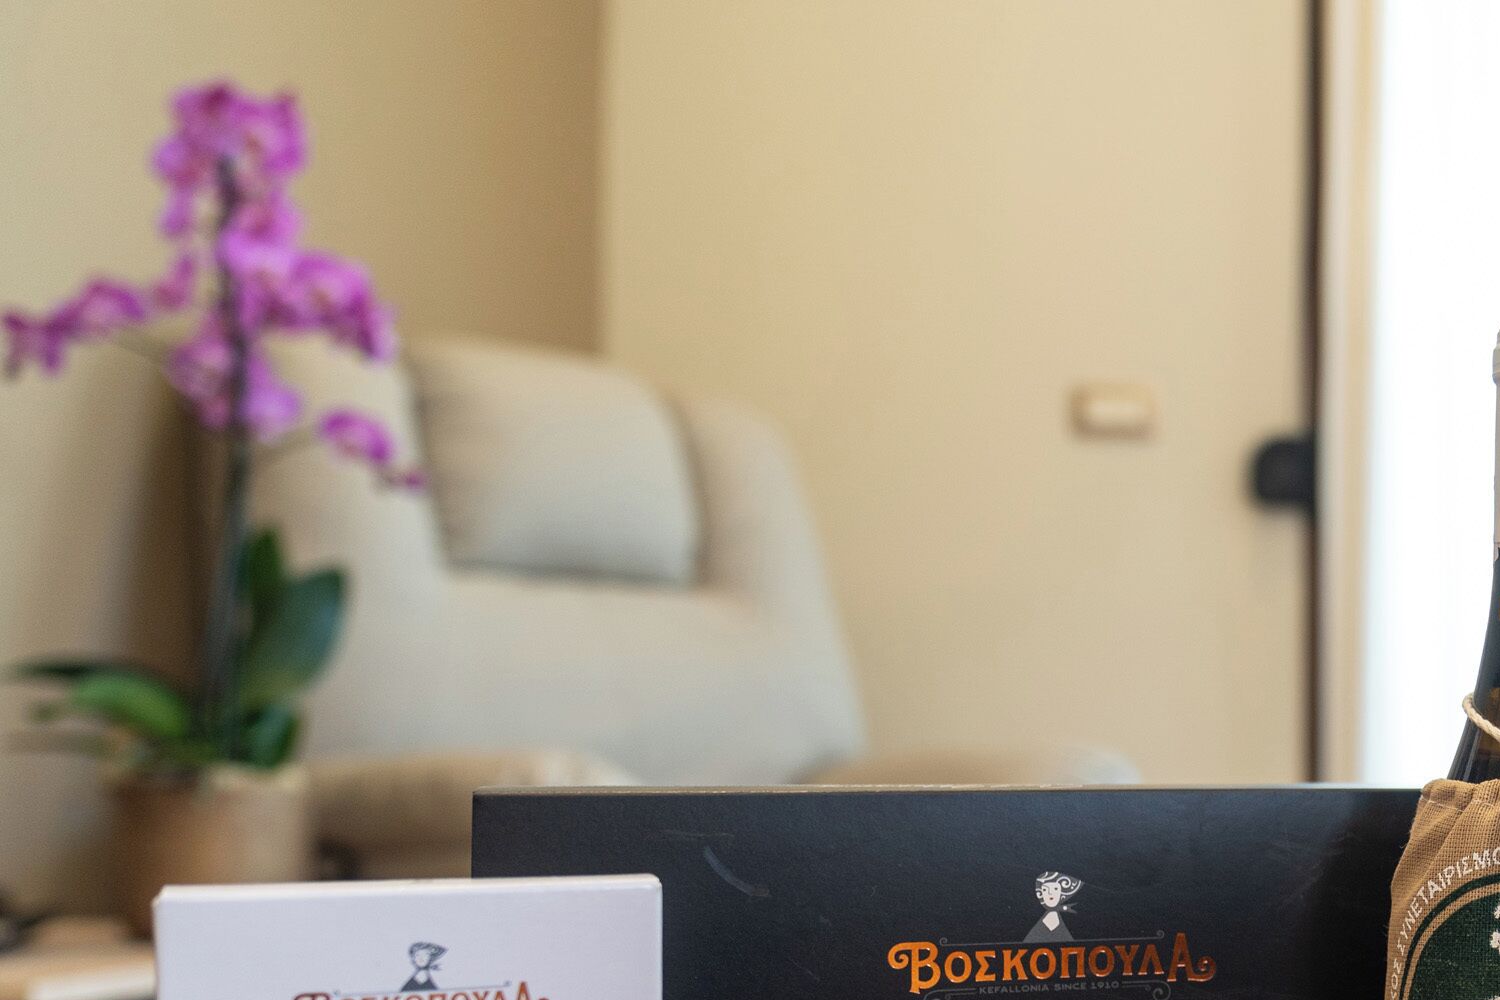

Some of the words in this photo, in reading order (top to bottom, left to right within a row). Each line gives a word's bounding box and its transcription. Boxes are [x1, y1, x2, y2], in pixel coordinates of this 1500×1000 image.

[888, 932, 1217, 994] ΒΟΣΚΟΠΟΥΛΑ
[979, 984, 1050, 995] KEFALLONIA
[1054, 982, 1087, 992] SINCE
[1090, 980, 1120, 990] 1910
